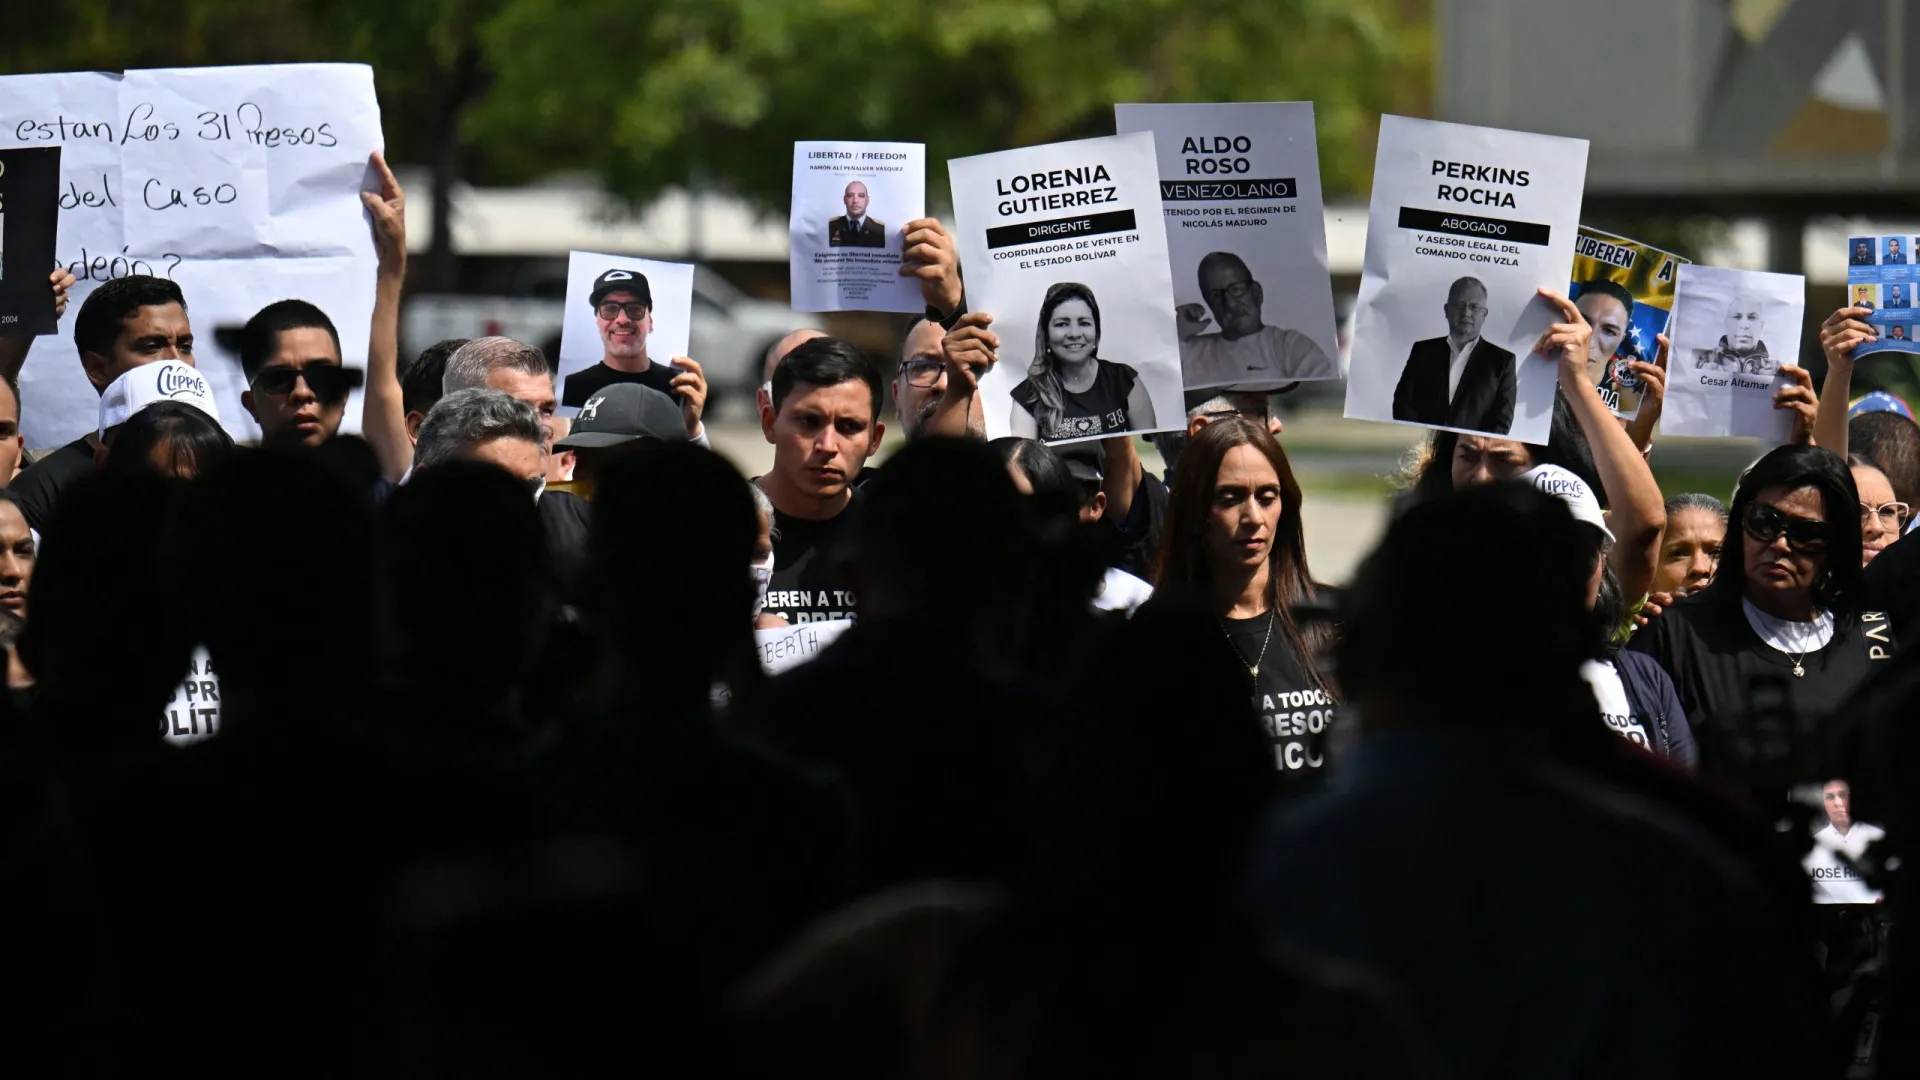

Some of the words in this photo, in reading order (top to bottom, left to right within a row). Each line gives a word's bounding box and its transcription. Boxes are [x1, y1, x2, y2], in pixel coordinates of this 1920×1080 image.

[16, 115, 113, 142] estan
[120, 102, 180, 146] Los
[197, 111, 231, 140] 31
[236, 102, 337, 148] Presos
[1181, 135, 1252, 154] ALDO
[808, 151, 852, 159] LIBERTAD
[861, 152, 907, 160] FREEDOM
[1185, 158, 1251, 175] ROSO
[1431, 160, 1530, 187] PERKINS
[996, 165, 1111, 197] LORENIA
[58, 173, 117, 210] del
[143, 178, 237, 211] Caso
[1162, 182, 1288, 199] VENEZOLANO
[1437, 184, 1517, 209] ROCHA
[997, 186, 1118, 216] GUTIERREZ
[1202, 208, 1222, 216] POR
[1238, 205, 1281, 215] RÉGIMEN
[1283, 205, 1297, 213] DE
[1028, 220, 1092, 238] DIRIGENTE
[1182, 218, 1223, 228] NICOLÁS
[1225, 218, 1268, 227] MADURO
[1440, 218, 1507, 235] ABOGADO
[993, 243, 1074, 261] COORDINADORA
[1075, 241, 1090, 250] DE
[1091, 236, 1124, 247] VENTE
[1126, 234, 1140, 243] EN
[1416, 234, 1424, 242] Y
[1425, 235, 1465, 248] ASESOR
[1467, 241, 1499, 252] LEGAL
[1501, 245, 1521, 254] DEL
[1019, 261, 1032, 269] EL
[1034, 255, 1073, 268] ESTADO
[1074, 250, 1117, 262] BOLÍVAR
[1415, 246, 1467, 260] COMANDO
[1469, 253, 1491, 263] CON
[1493, 256, 1519, 267] VZLA
[1574, 235, 1635, 268] LIBEREN
[1658, 260, 1674, 281] A
[1, 315, 18, 324] 2004
[1700, 375, 1728, 387] Cesar
[1730, 378, 1769, 390] Altamar
[817, 590, 830, 607] A
[1262, 694, 1276, 710] A
[1808, 865, 1842, 879] JOSÉ
